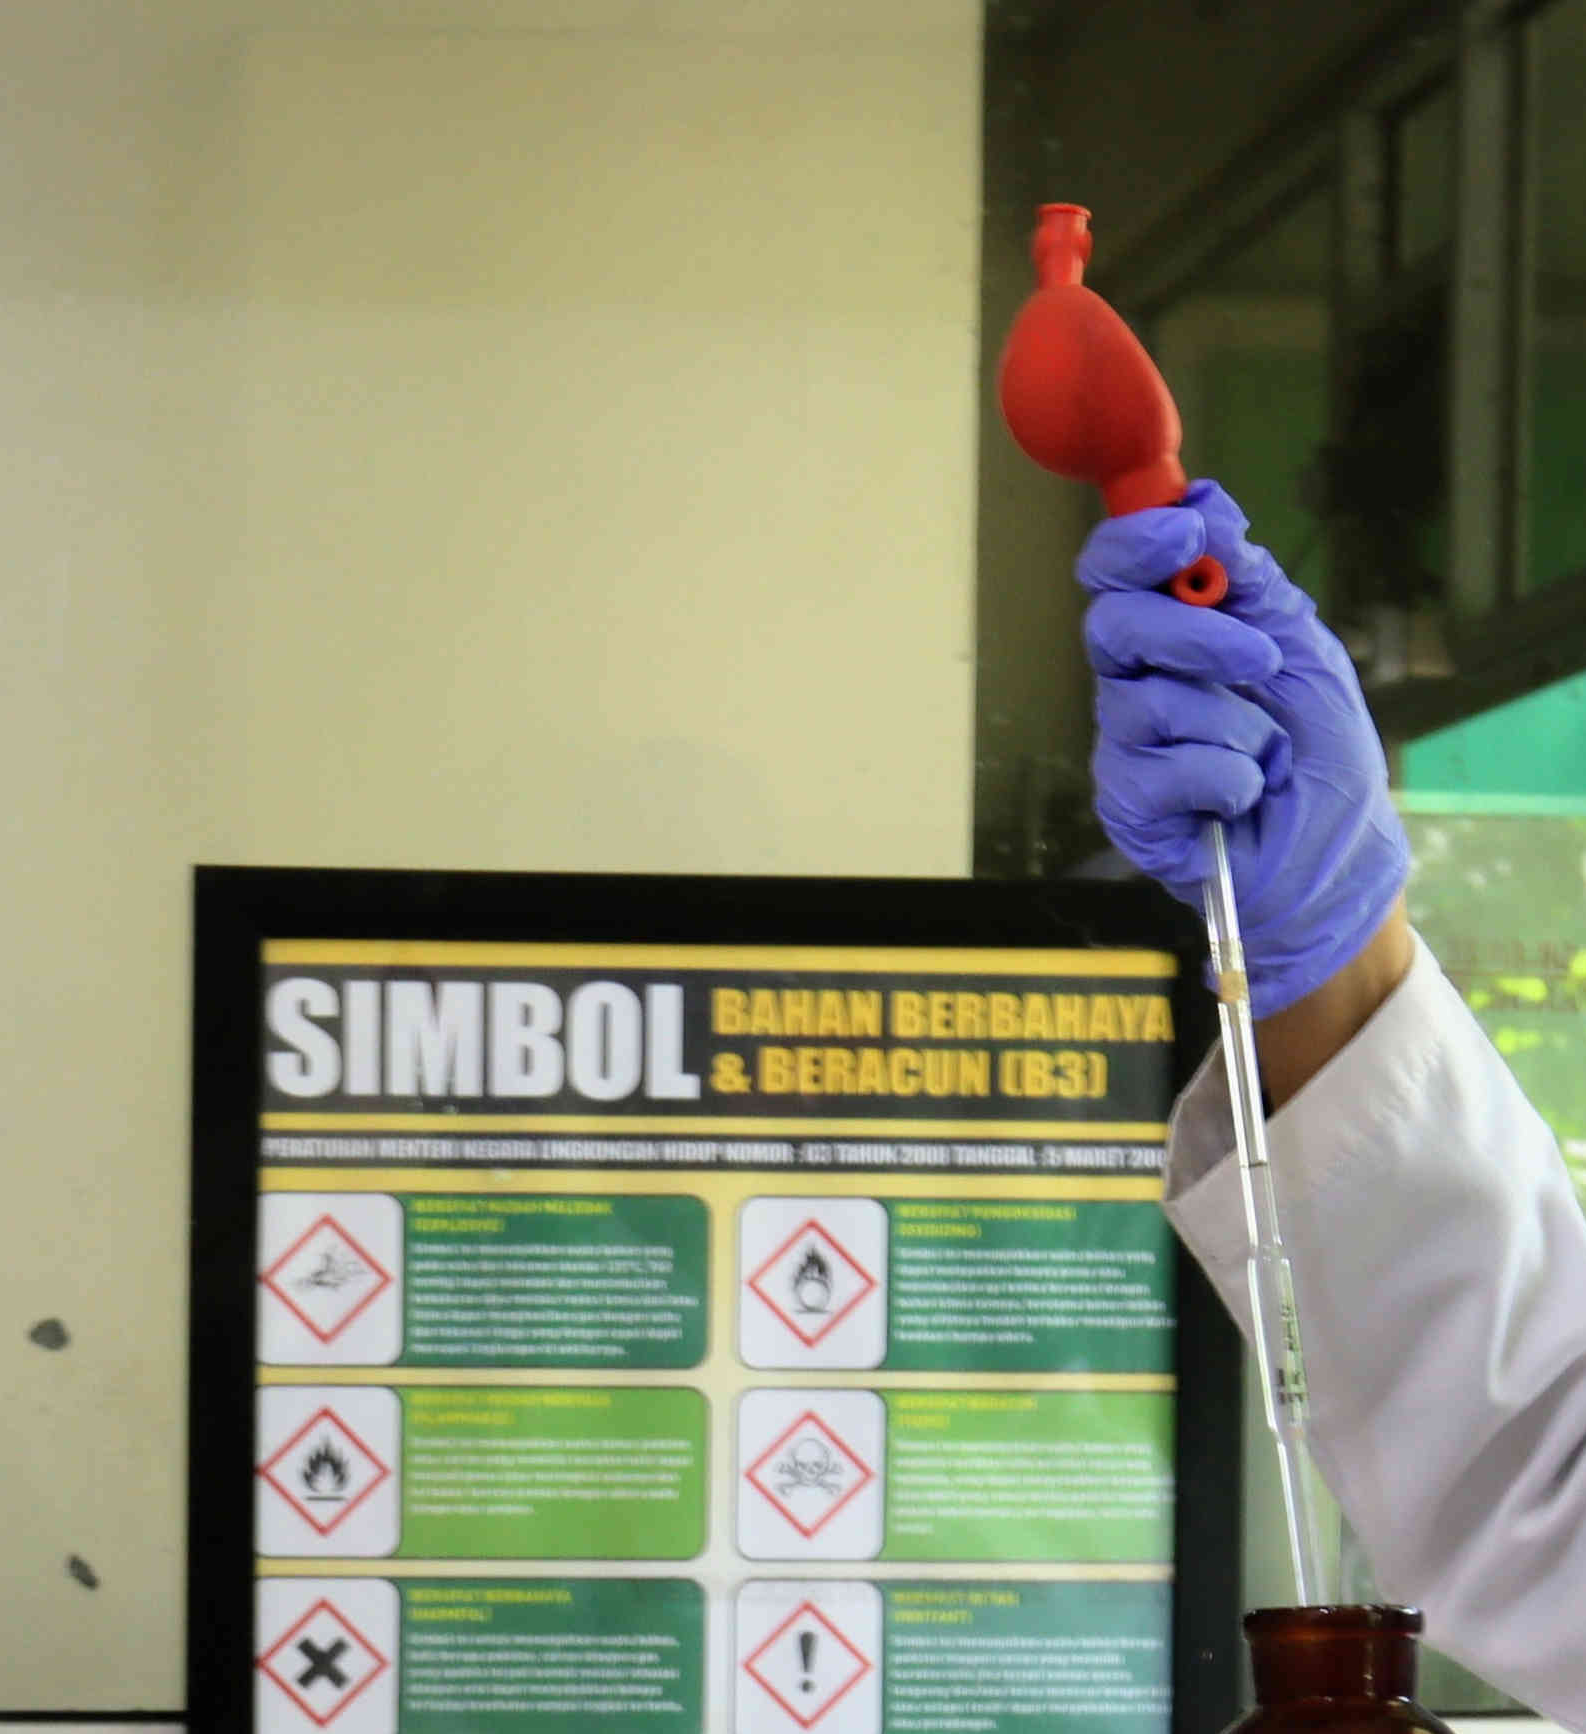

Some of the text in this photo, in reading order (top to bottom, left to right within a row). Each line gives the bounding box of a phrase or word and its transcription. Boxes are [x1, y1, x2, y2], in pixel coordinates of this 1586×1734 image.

[265, 978, 702, 1101] SIMBOL
[712, 988, 1175, 1042] BAHAN BERBAHAYA
[711, 1048, 1107, 1098] & BERACUN (B3)
